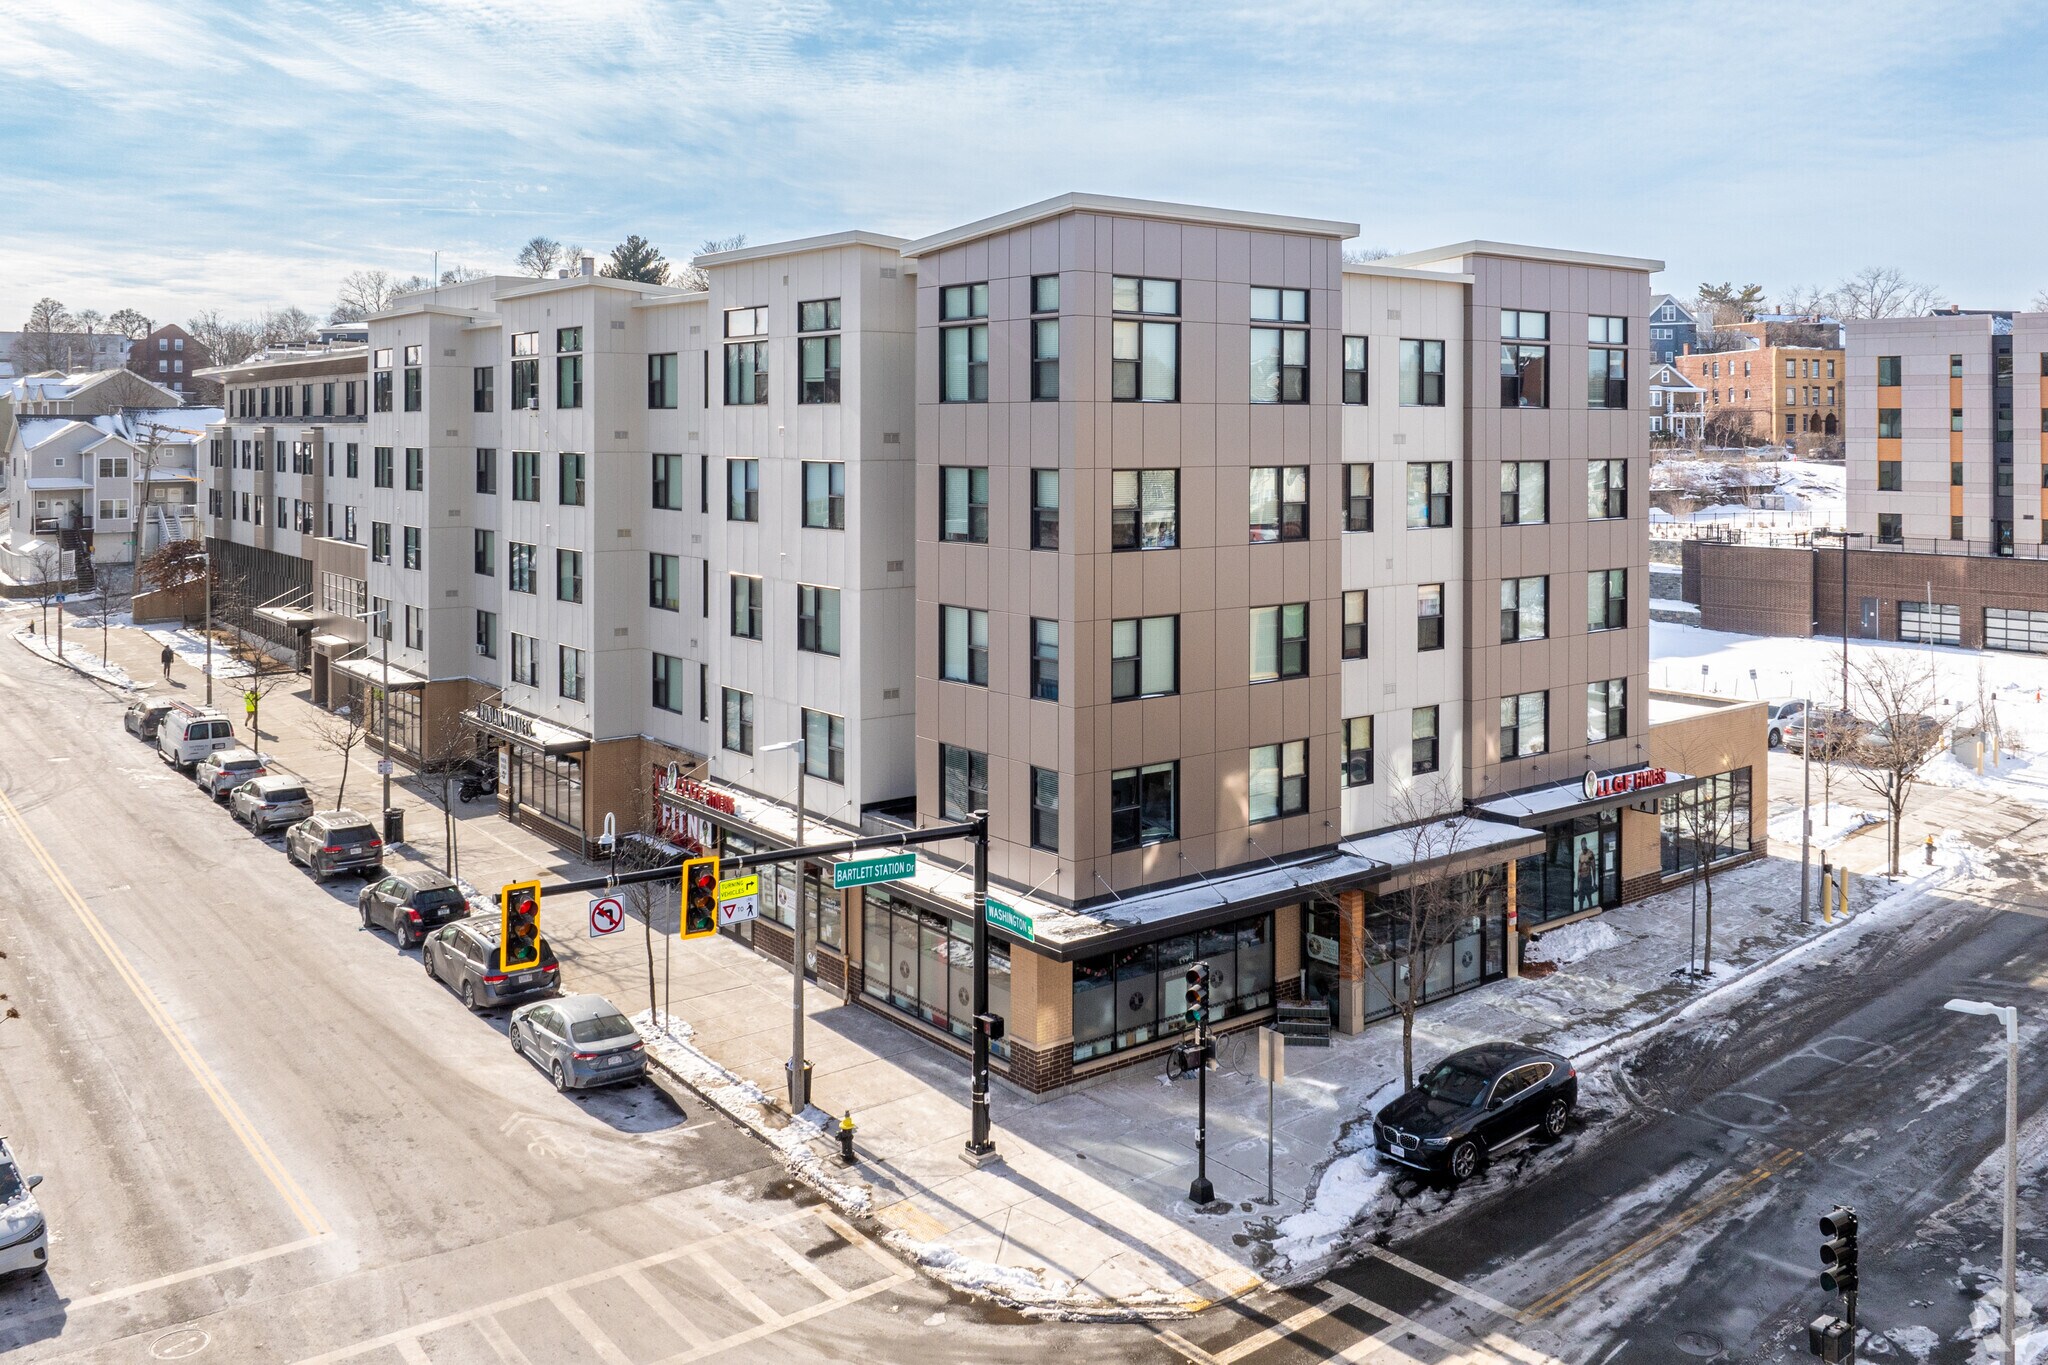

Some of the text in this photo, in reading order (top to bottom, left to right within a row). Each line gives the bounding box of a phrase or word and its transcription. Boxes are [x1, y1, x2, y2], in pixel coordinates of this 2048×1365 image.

[1597, 767, 1666, 797] LLGF FITNESS
[662, 803, 698, 840] FITN
[837, 861, 915, 882] BARTLETT STATION Dr
[721, 880, 744, 890] TURNING
[721, 888, 745, 897] VEHICLES
[988, 904, 1027, 931] WASHINGTON
